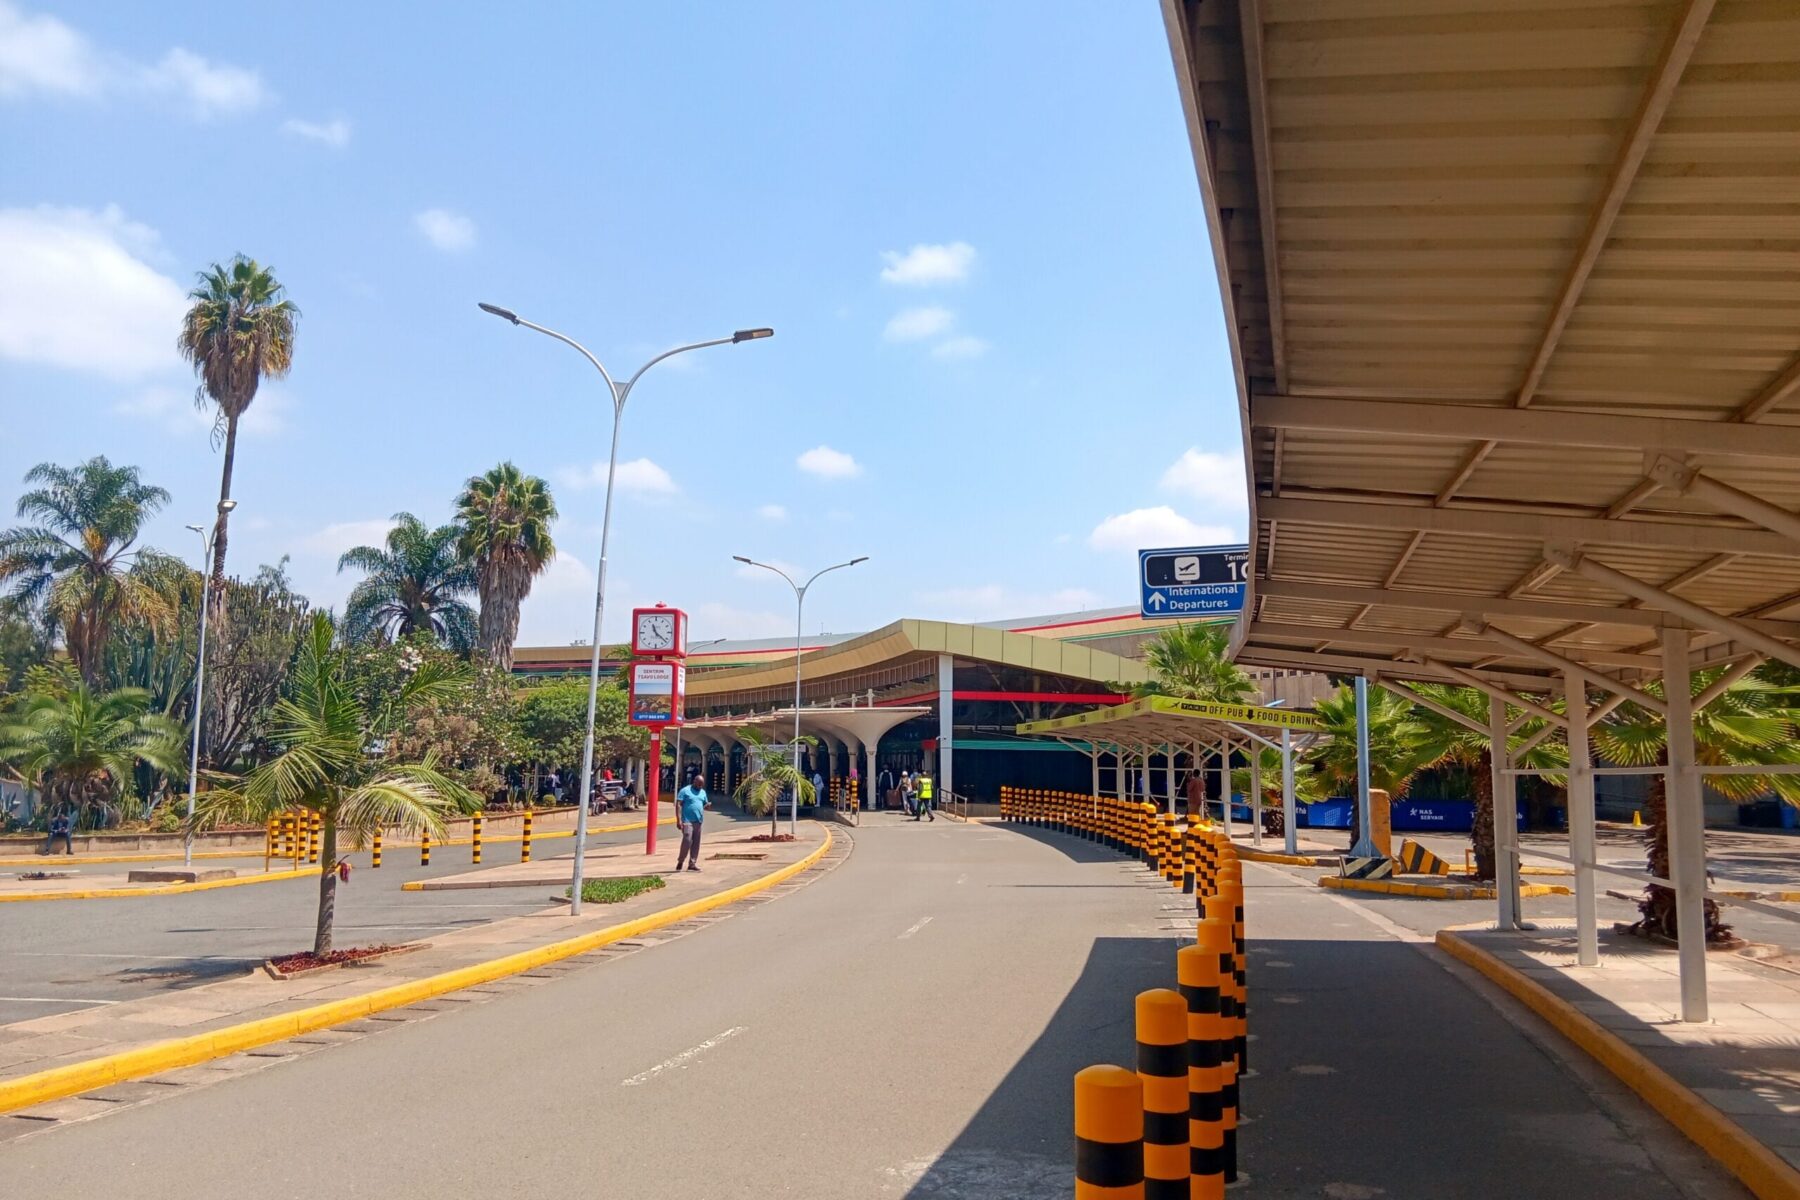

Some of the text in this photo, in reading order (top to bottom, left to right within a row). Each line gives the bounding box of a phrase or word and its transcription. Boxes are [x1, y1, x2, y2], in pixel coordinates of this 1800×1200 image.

[1169, 584, 1238, 596] International
[1170, 600, 1229, 611] Departures
[1209, 706, 1224, 715] OFF
[1227, 707, 1243, 718] PUB
[1257, 712, 1279, 722] FOOD
[1282, 714, 1287, 723] &
